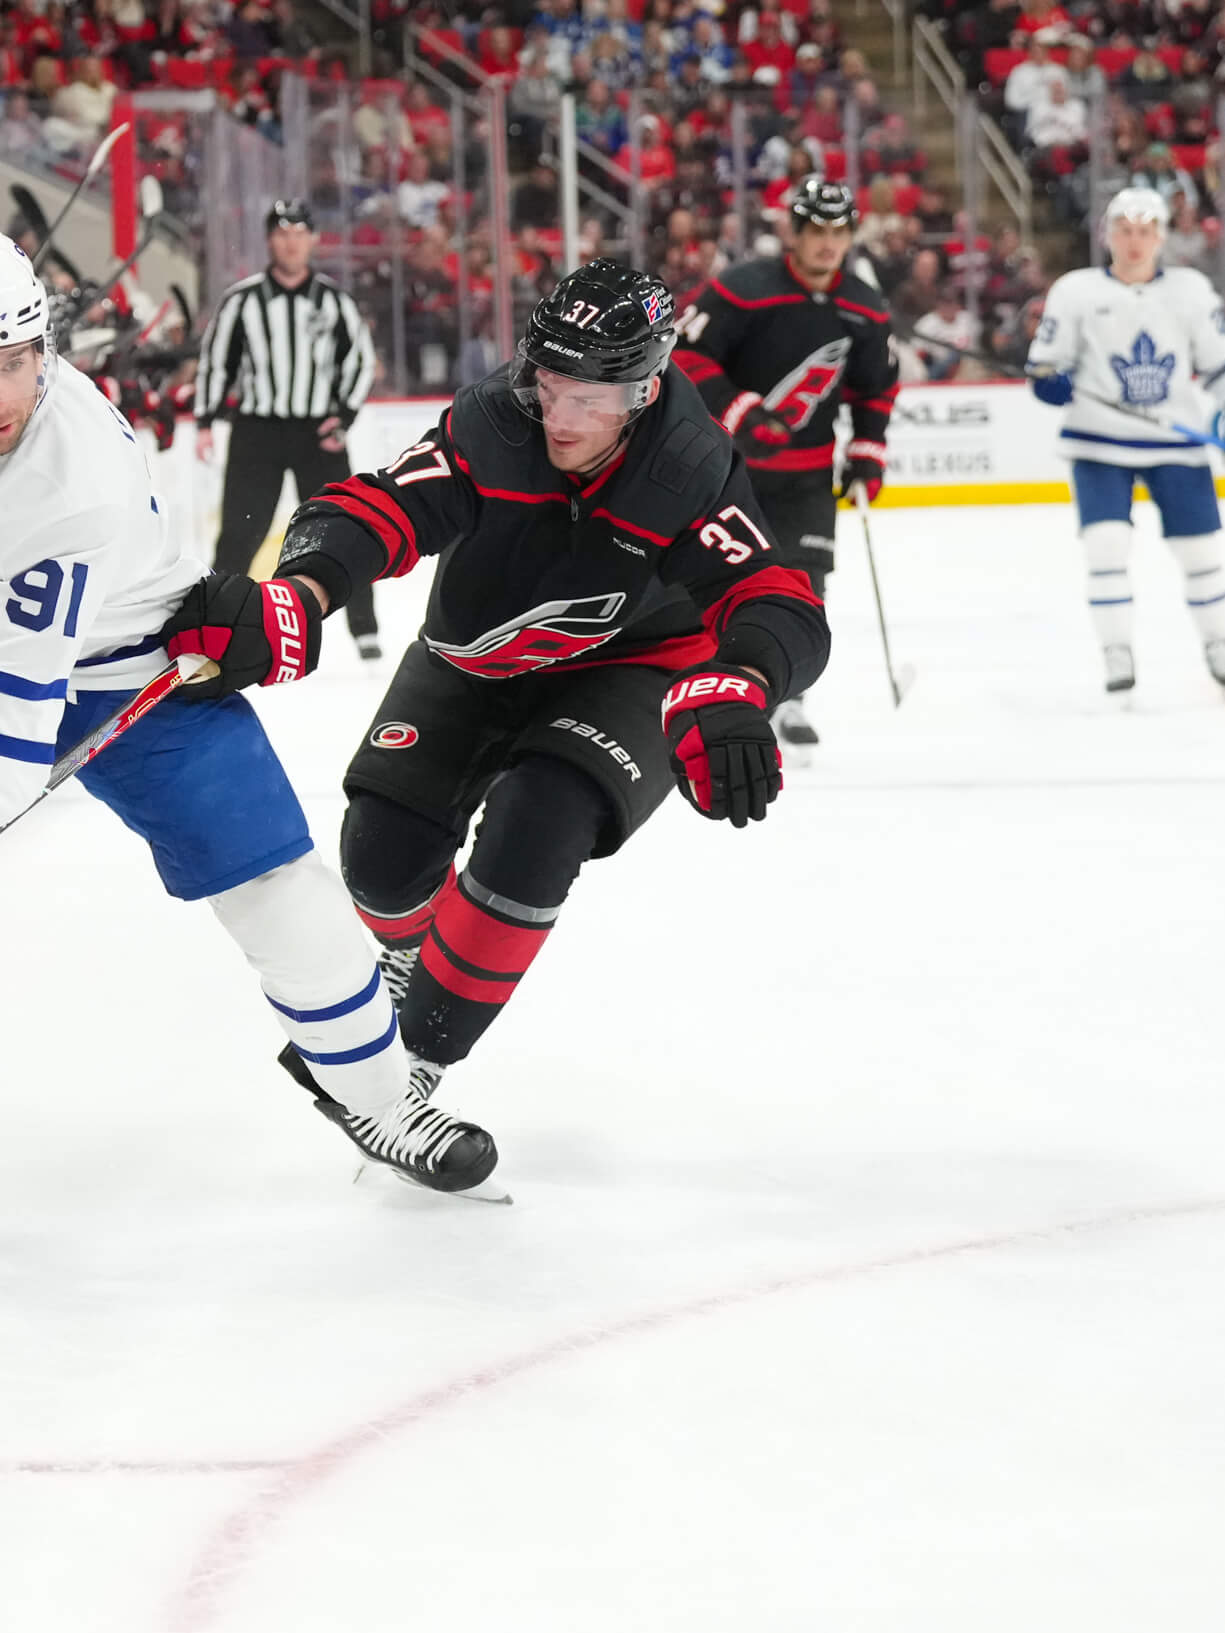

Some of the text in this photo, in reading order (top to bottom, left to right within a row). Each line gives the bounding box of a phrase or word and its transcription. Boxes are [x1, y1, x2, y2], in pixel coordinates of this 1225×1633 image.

[562, 300, 600, 329] 37
[542, 340, 584, 360] BAUER
[699, 504, 771, 564] 37
[5, 558, 88, 638] 91
[266, 583, 302, 684] BAUE
[662, 677, 749, 714] UER
[549, 717, 642, 783] BAUER
